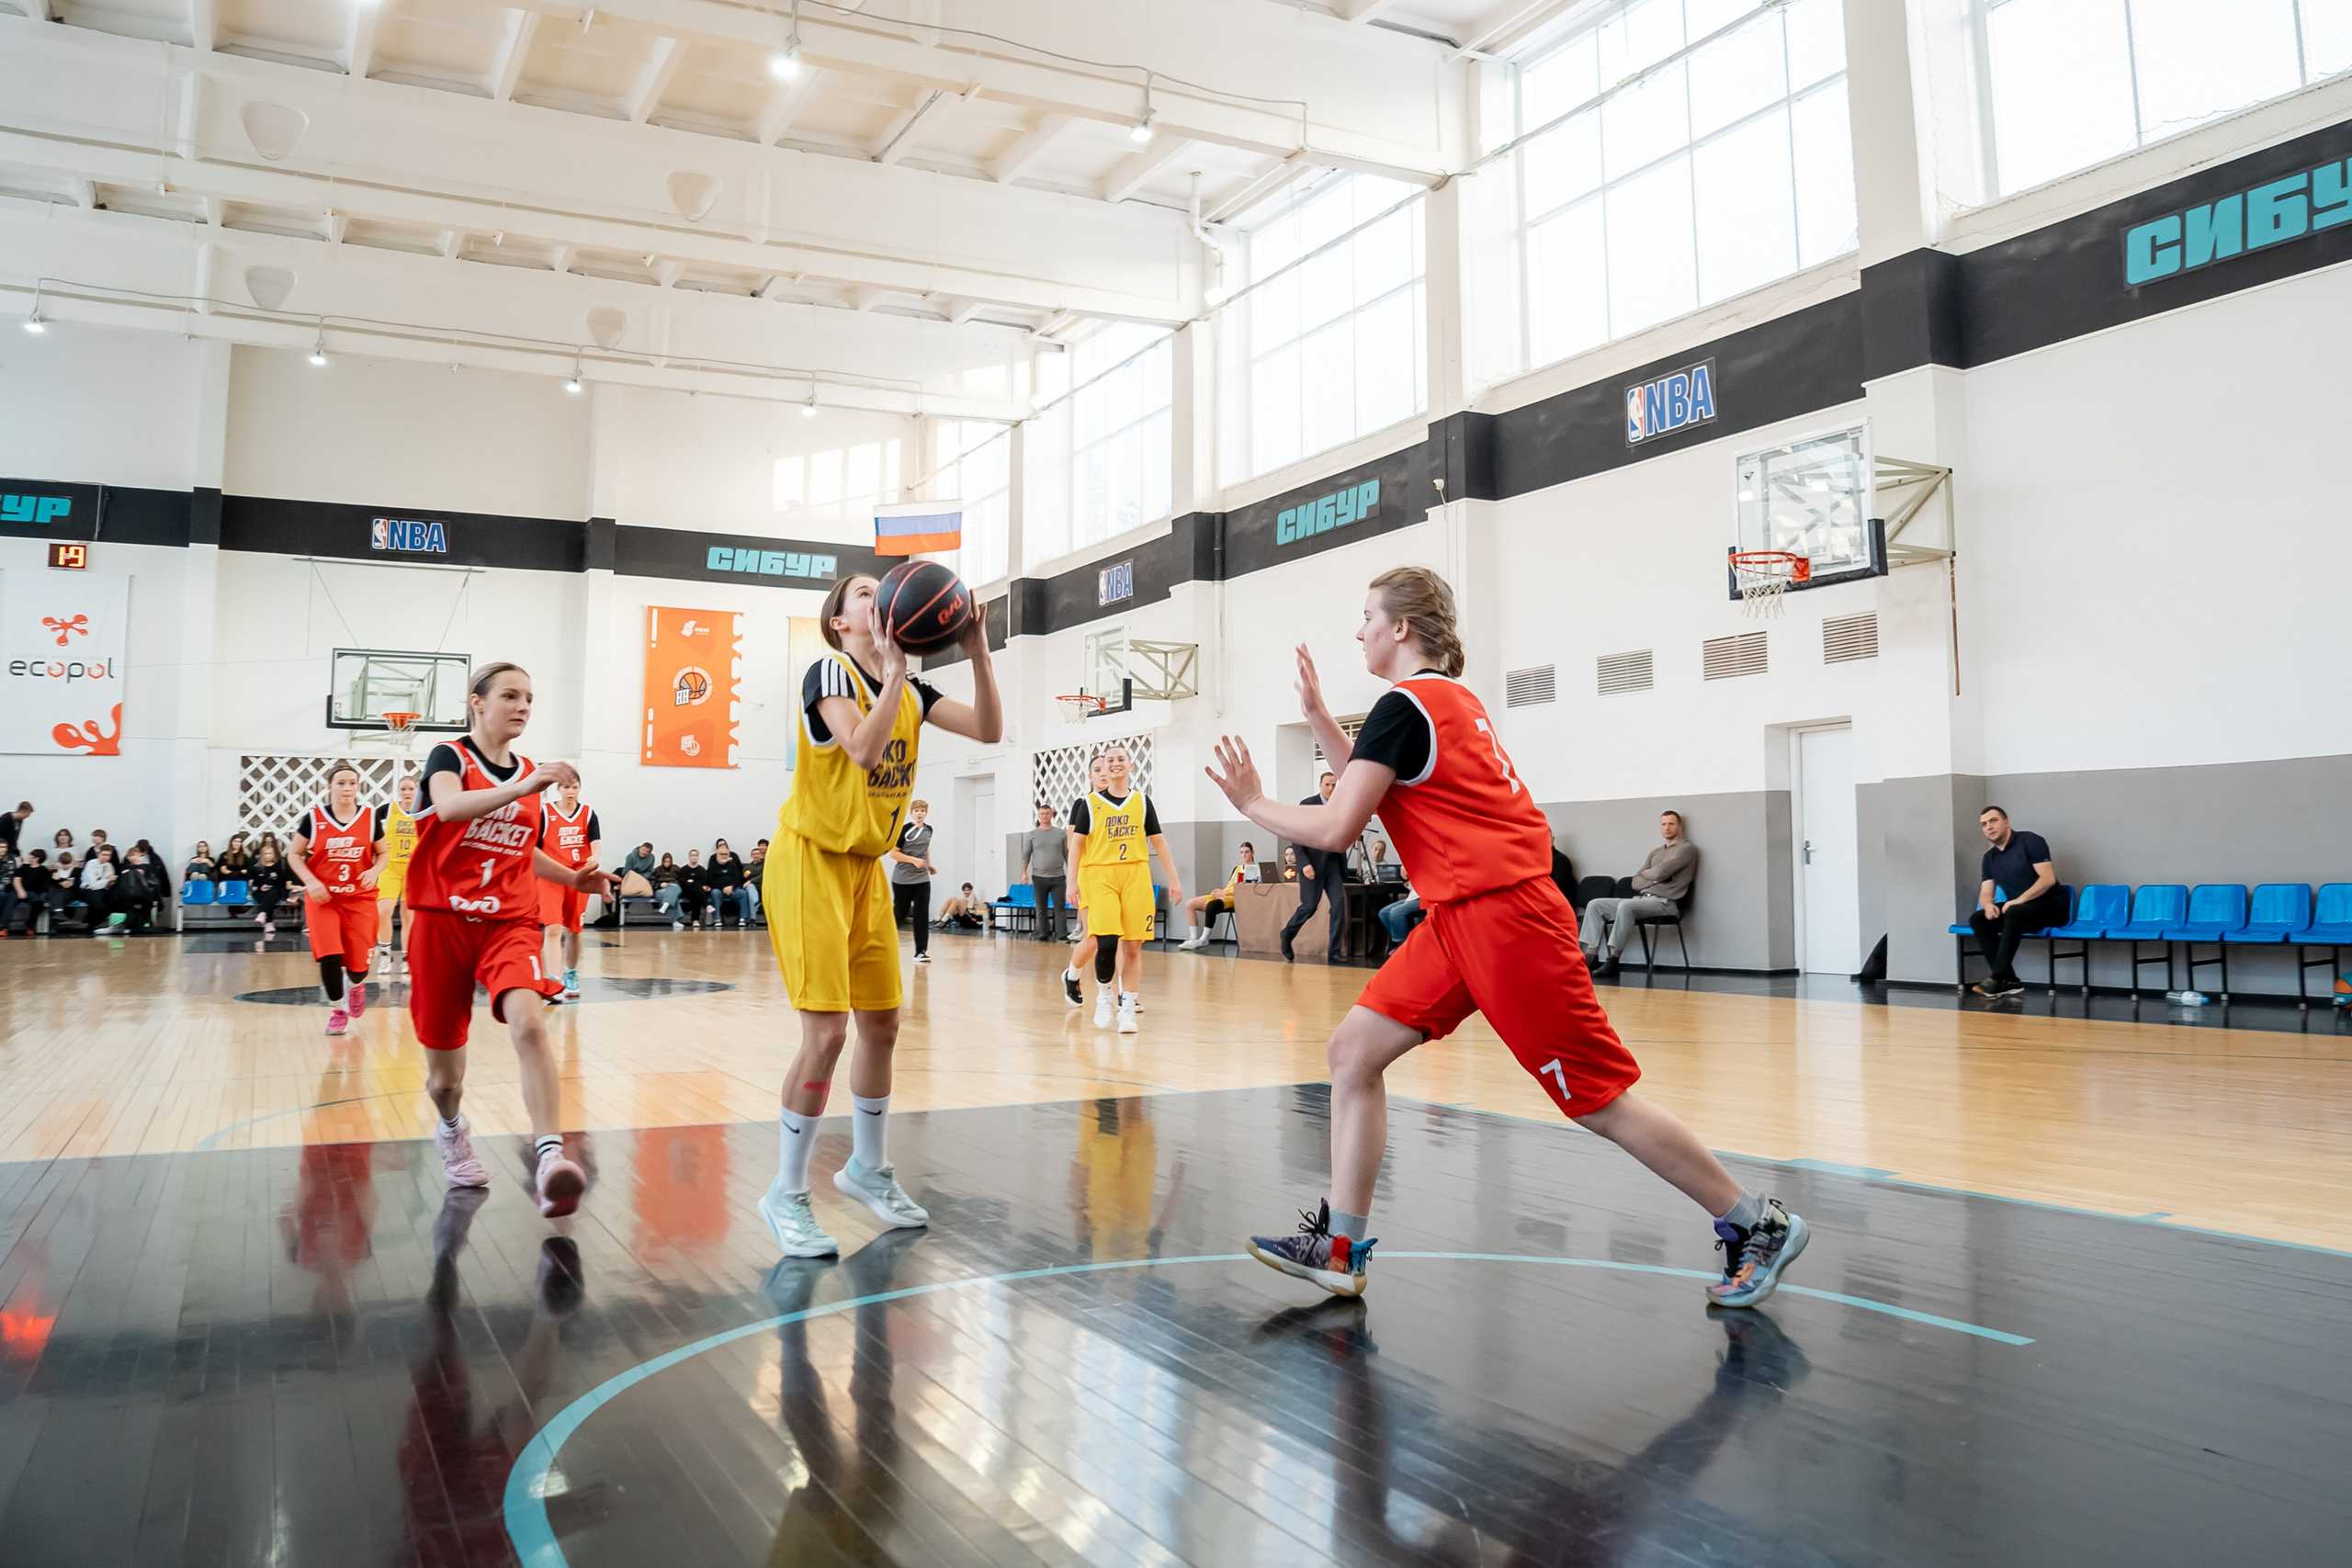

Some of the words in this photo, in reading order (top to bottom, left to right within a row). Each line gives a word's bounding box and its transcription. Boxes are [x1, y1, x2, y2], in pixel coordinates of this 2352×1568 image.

[1645, 366, 1715, 436] NBA
[0, 494, 72, 523] УР
[1276, 479, 1379, 546] СИБУР
[388, 520, 447, 553] NBA
[58, 546, 85, 567] 19
[707, 547, 836, 578] СИБУР
[1106, 562, 1134, 603] NBA
[9, 657, 114, 683] ecopol
[464, 818, 534, 848] БАСКЕТ
[886, 806, 900, 842] 1
[571, 849, 581, 862] 6
[1119, 843, 1127, 861] 2
[338, 864, 350, 882] 3
[480, 858, 496, 888] 1
[1146, 915, 1154, 932] 2
[529, 955, 541, 981] 1
[1540, 1058, 1572, 1100] 7
